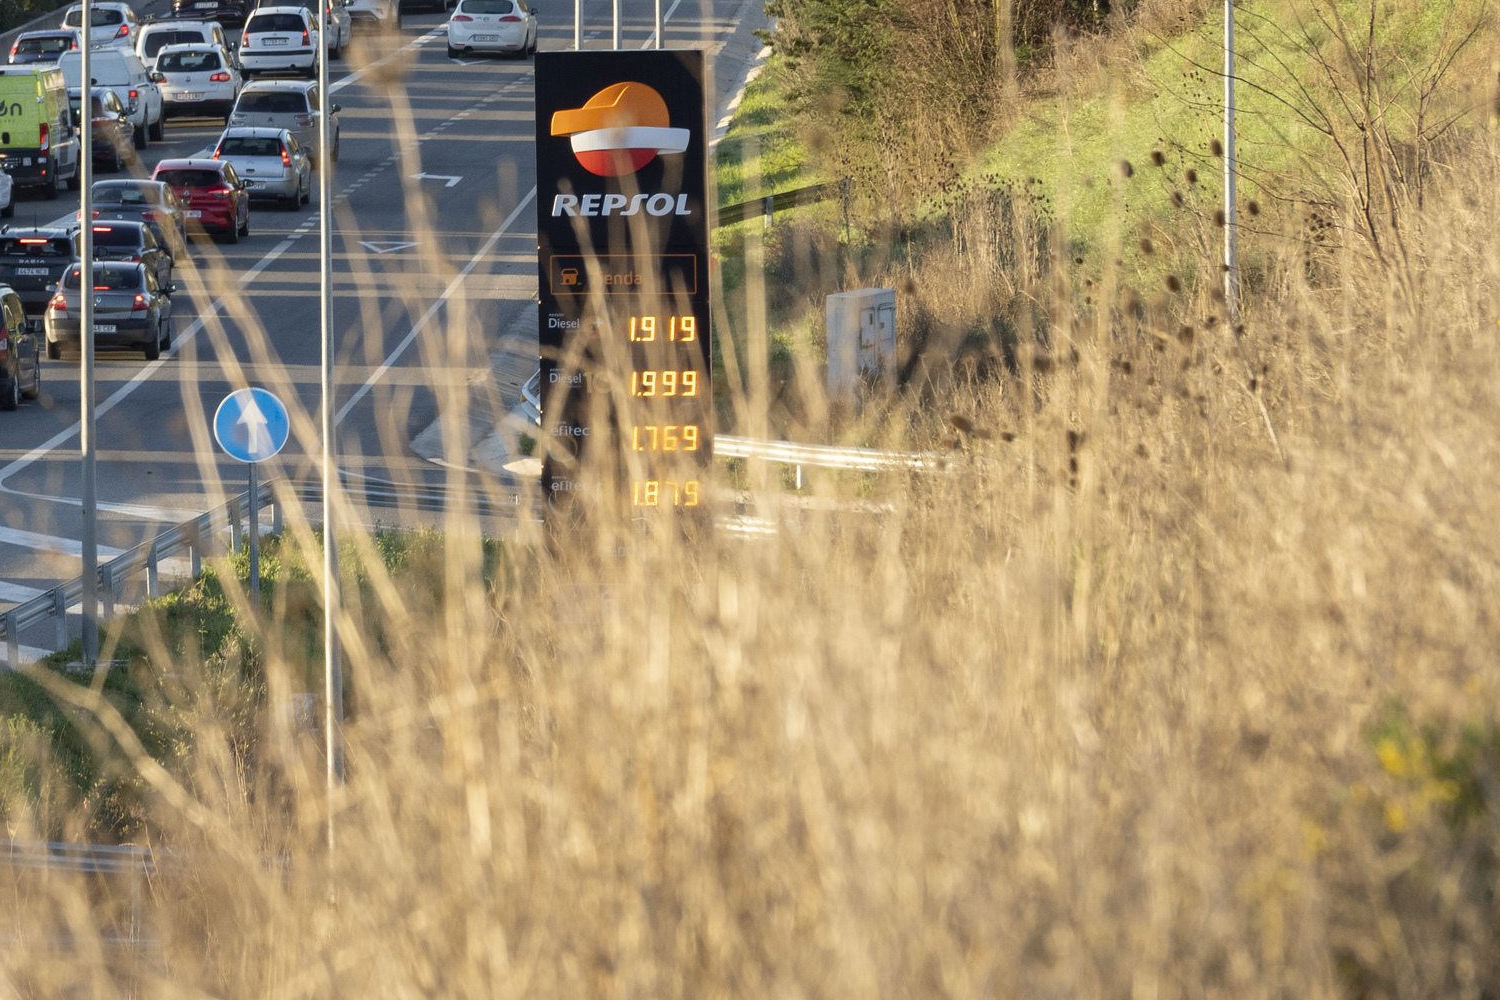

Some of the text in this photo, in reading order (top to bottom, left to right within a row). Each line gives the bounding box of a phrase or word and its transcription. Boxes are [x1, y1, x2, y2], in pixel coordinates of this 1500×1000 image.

[551, 192, 692, 217] REPSOL
[548, 317, 580, 329] Diesel
[630, 316, 696, 342] 1.919
[549, 373, 582, 384] Diesel
[631, 370, 698, 397] 1.999
[551, 425, 590, 437] efitec
[632, 425, 699, 451] 1.769
